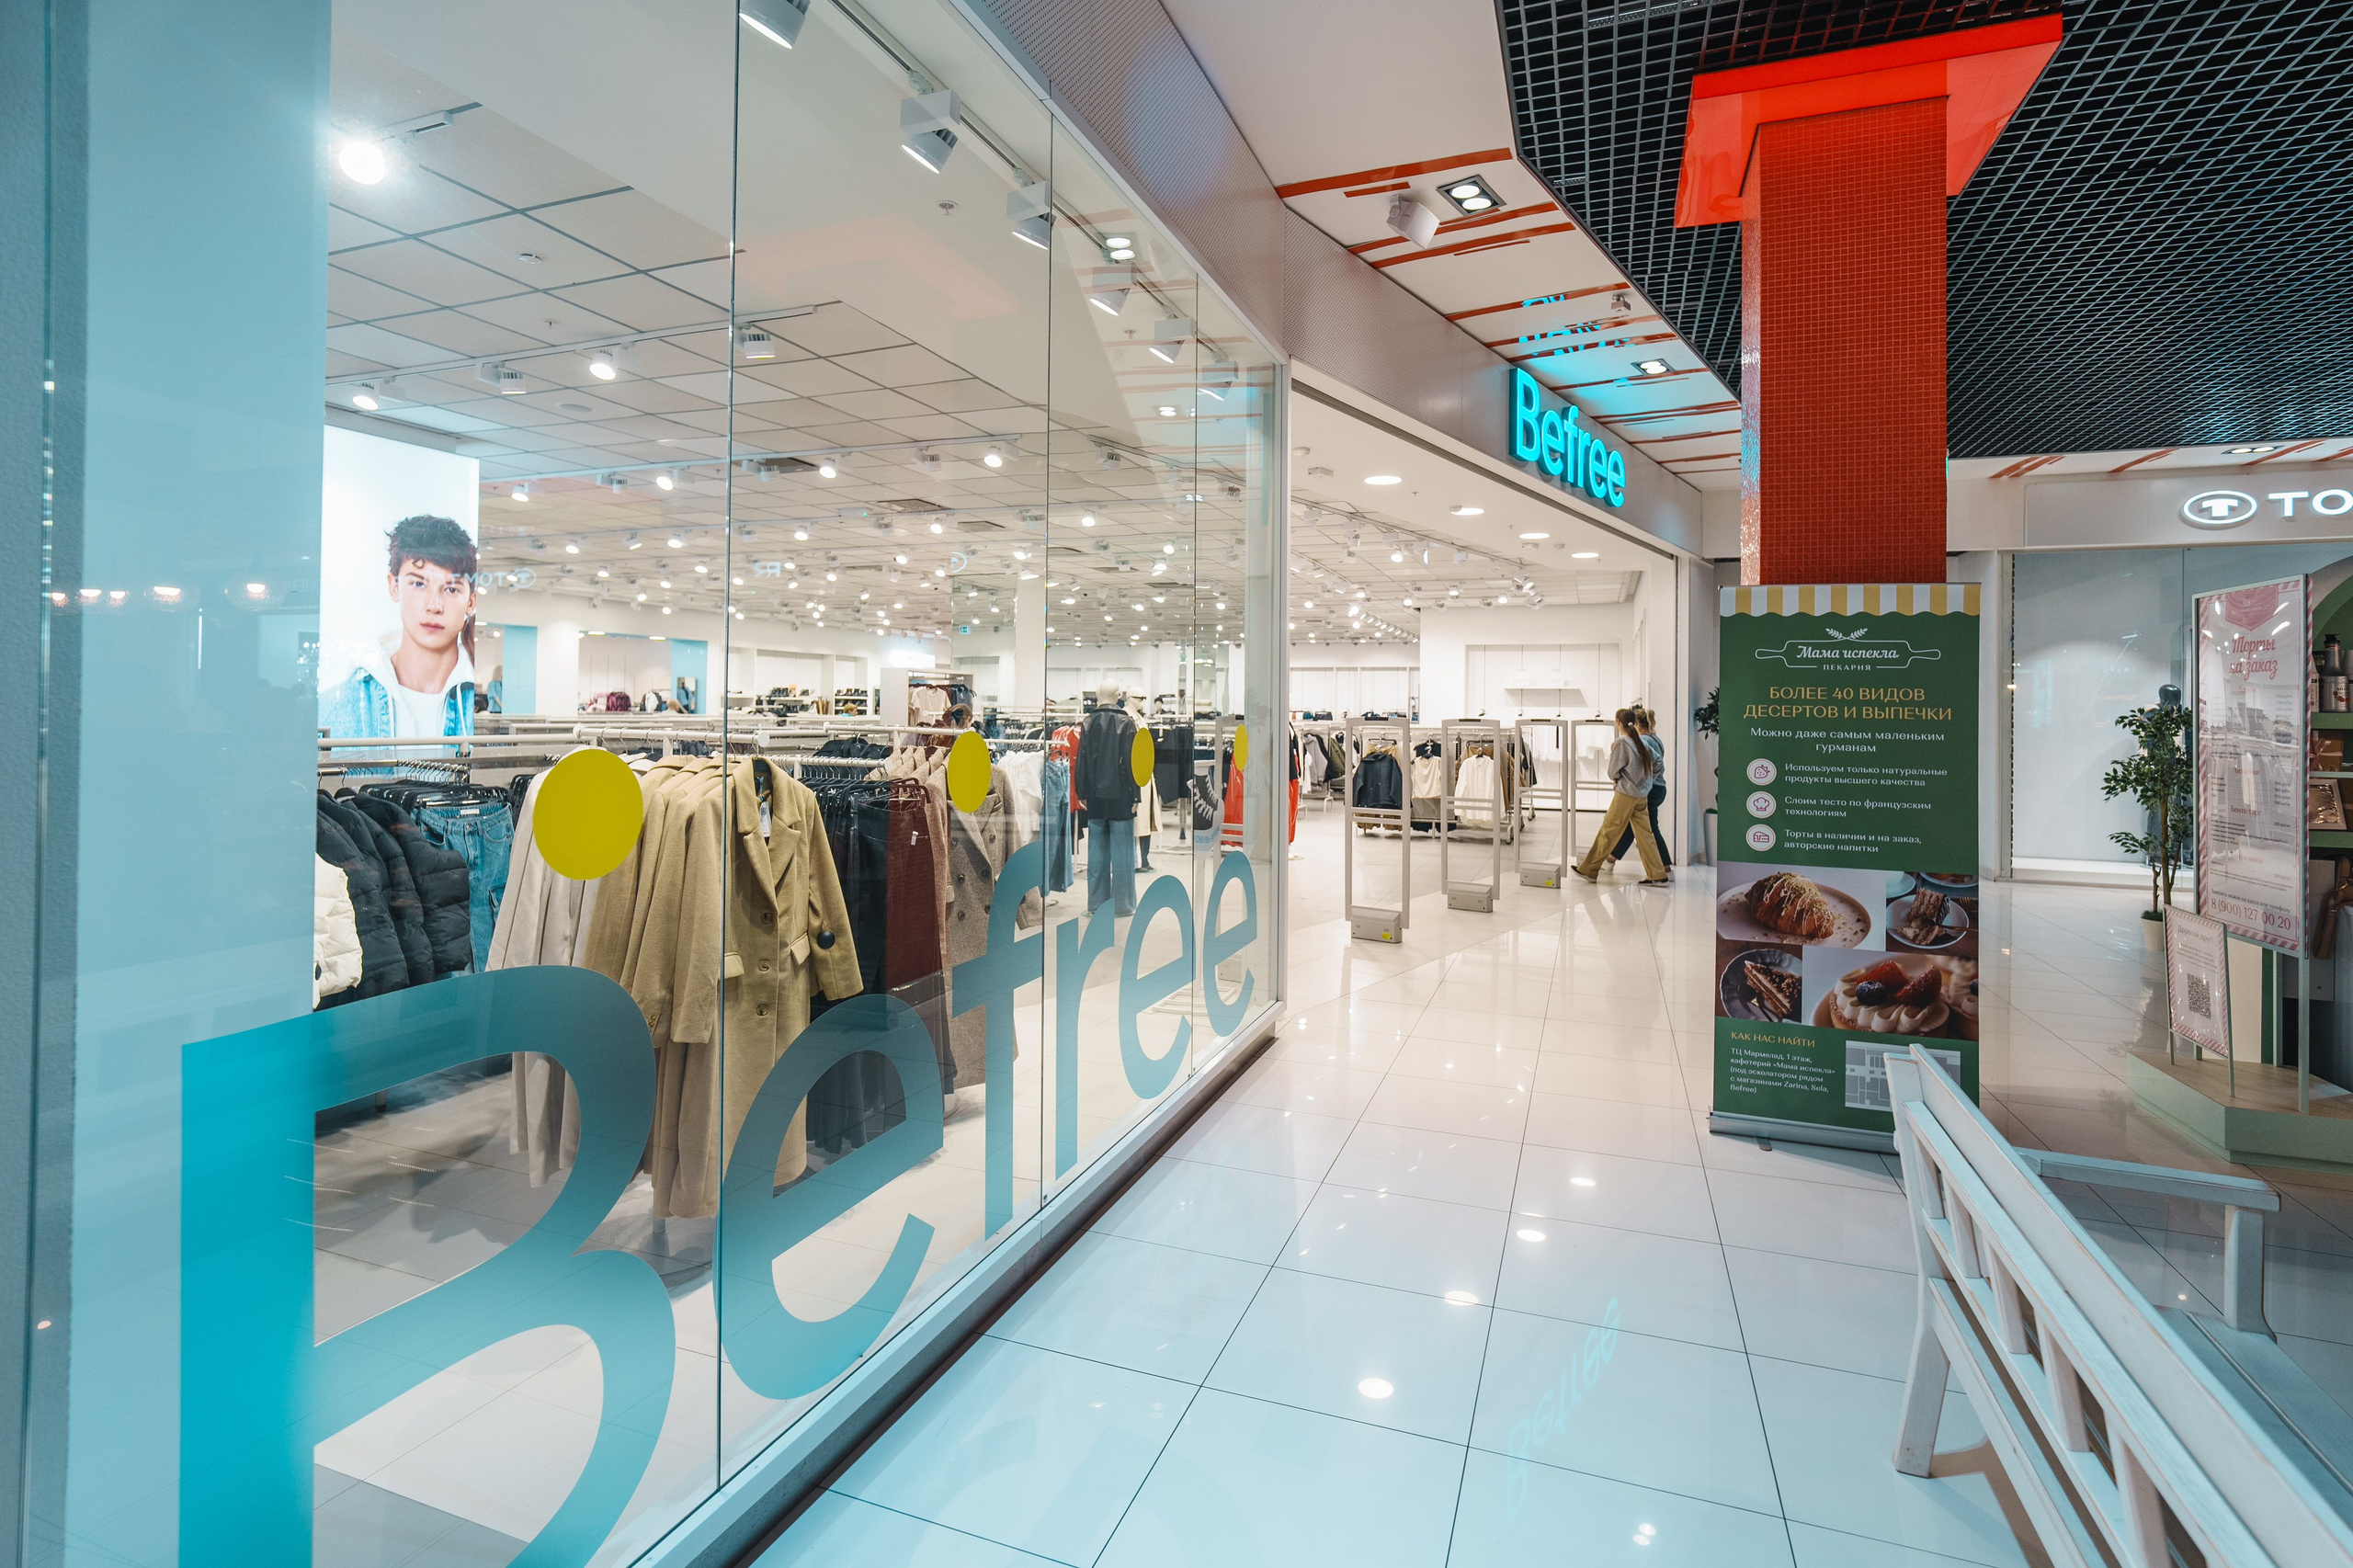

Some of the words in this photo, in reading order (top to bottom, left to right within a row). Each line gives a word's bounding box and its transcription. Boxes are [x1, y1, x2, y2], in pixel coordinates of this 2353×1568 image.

[1510, 367, 1626, 507] Befree
[1796, 645, 1839, 658] Мама
[1842, 649, 1899, 658] испекла
[2244, 659, 2278, 681] заказ
[1769, 687, 1827, 699] БОЛЕЕ
[1833, 687, 1854, 700] 40
[1859, 687, 1926, 703] ВИДОВ
[1744, 704, 1838, 720] ДЕСЕРТОВ
[1844, 706, 1857, 719] И
[1862, 706, 1951, 721] ВЫПЕЧКИ
[1750, 727, 1792, 738] Можно
[1795, 730, 1826, 739] даже
[1829, 732, 1871, 740] самым
[1875, 733, 1945, 741] маленьким
[1815, 743, 1876, 754] гурманам
[1785, 763, 1844, 774] Используем
[1881, 767, 1948, 777] натуральные
[1785, 775, 1832, 784] продукты
[1881, 778, 1926, 787] качества
[1784, 796, 1816, 805] Слоим
[1864, 799, 1931, 810] французским
[1785, 809, 1847, 817] технологиям
[1784, 829, 1813, 839] Торты
[1824, 833, 1866, 841] наличии
[1893, 835, 1922, 845] заказ,
[1784, 841, 1835, 851] авторские
[1837, 845, 1879, 853] напитки
[2211, 898, 2217, 910] 8
[2218, 900, 2242, 918] (900)
[2244, 906, 2258, 921] 127
[2262, 911, 2275, 926] 00
[2278, 915, 2291, 930] 20
[1731, 1031, 1751, 1041] КАК
[1753, 1033, 1776, 1043] НАС
[1778, 1036, 1815, 1048] НАЙТИ
[1731, 1048, 1743, 1056] ТЦ
[1791, 1055, 1813, 1063] этаж,
[1730, 1058, 1771, 1068] кафетерий
[1730, 1066, 1746, 1074] (под
[1799, 1074, 1824, 1083] рядом
[1736, 1076, 1782, 1087] магазинами
[180, 842, 1258, 1568] Befree
